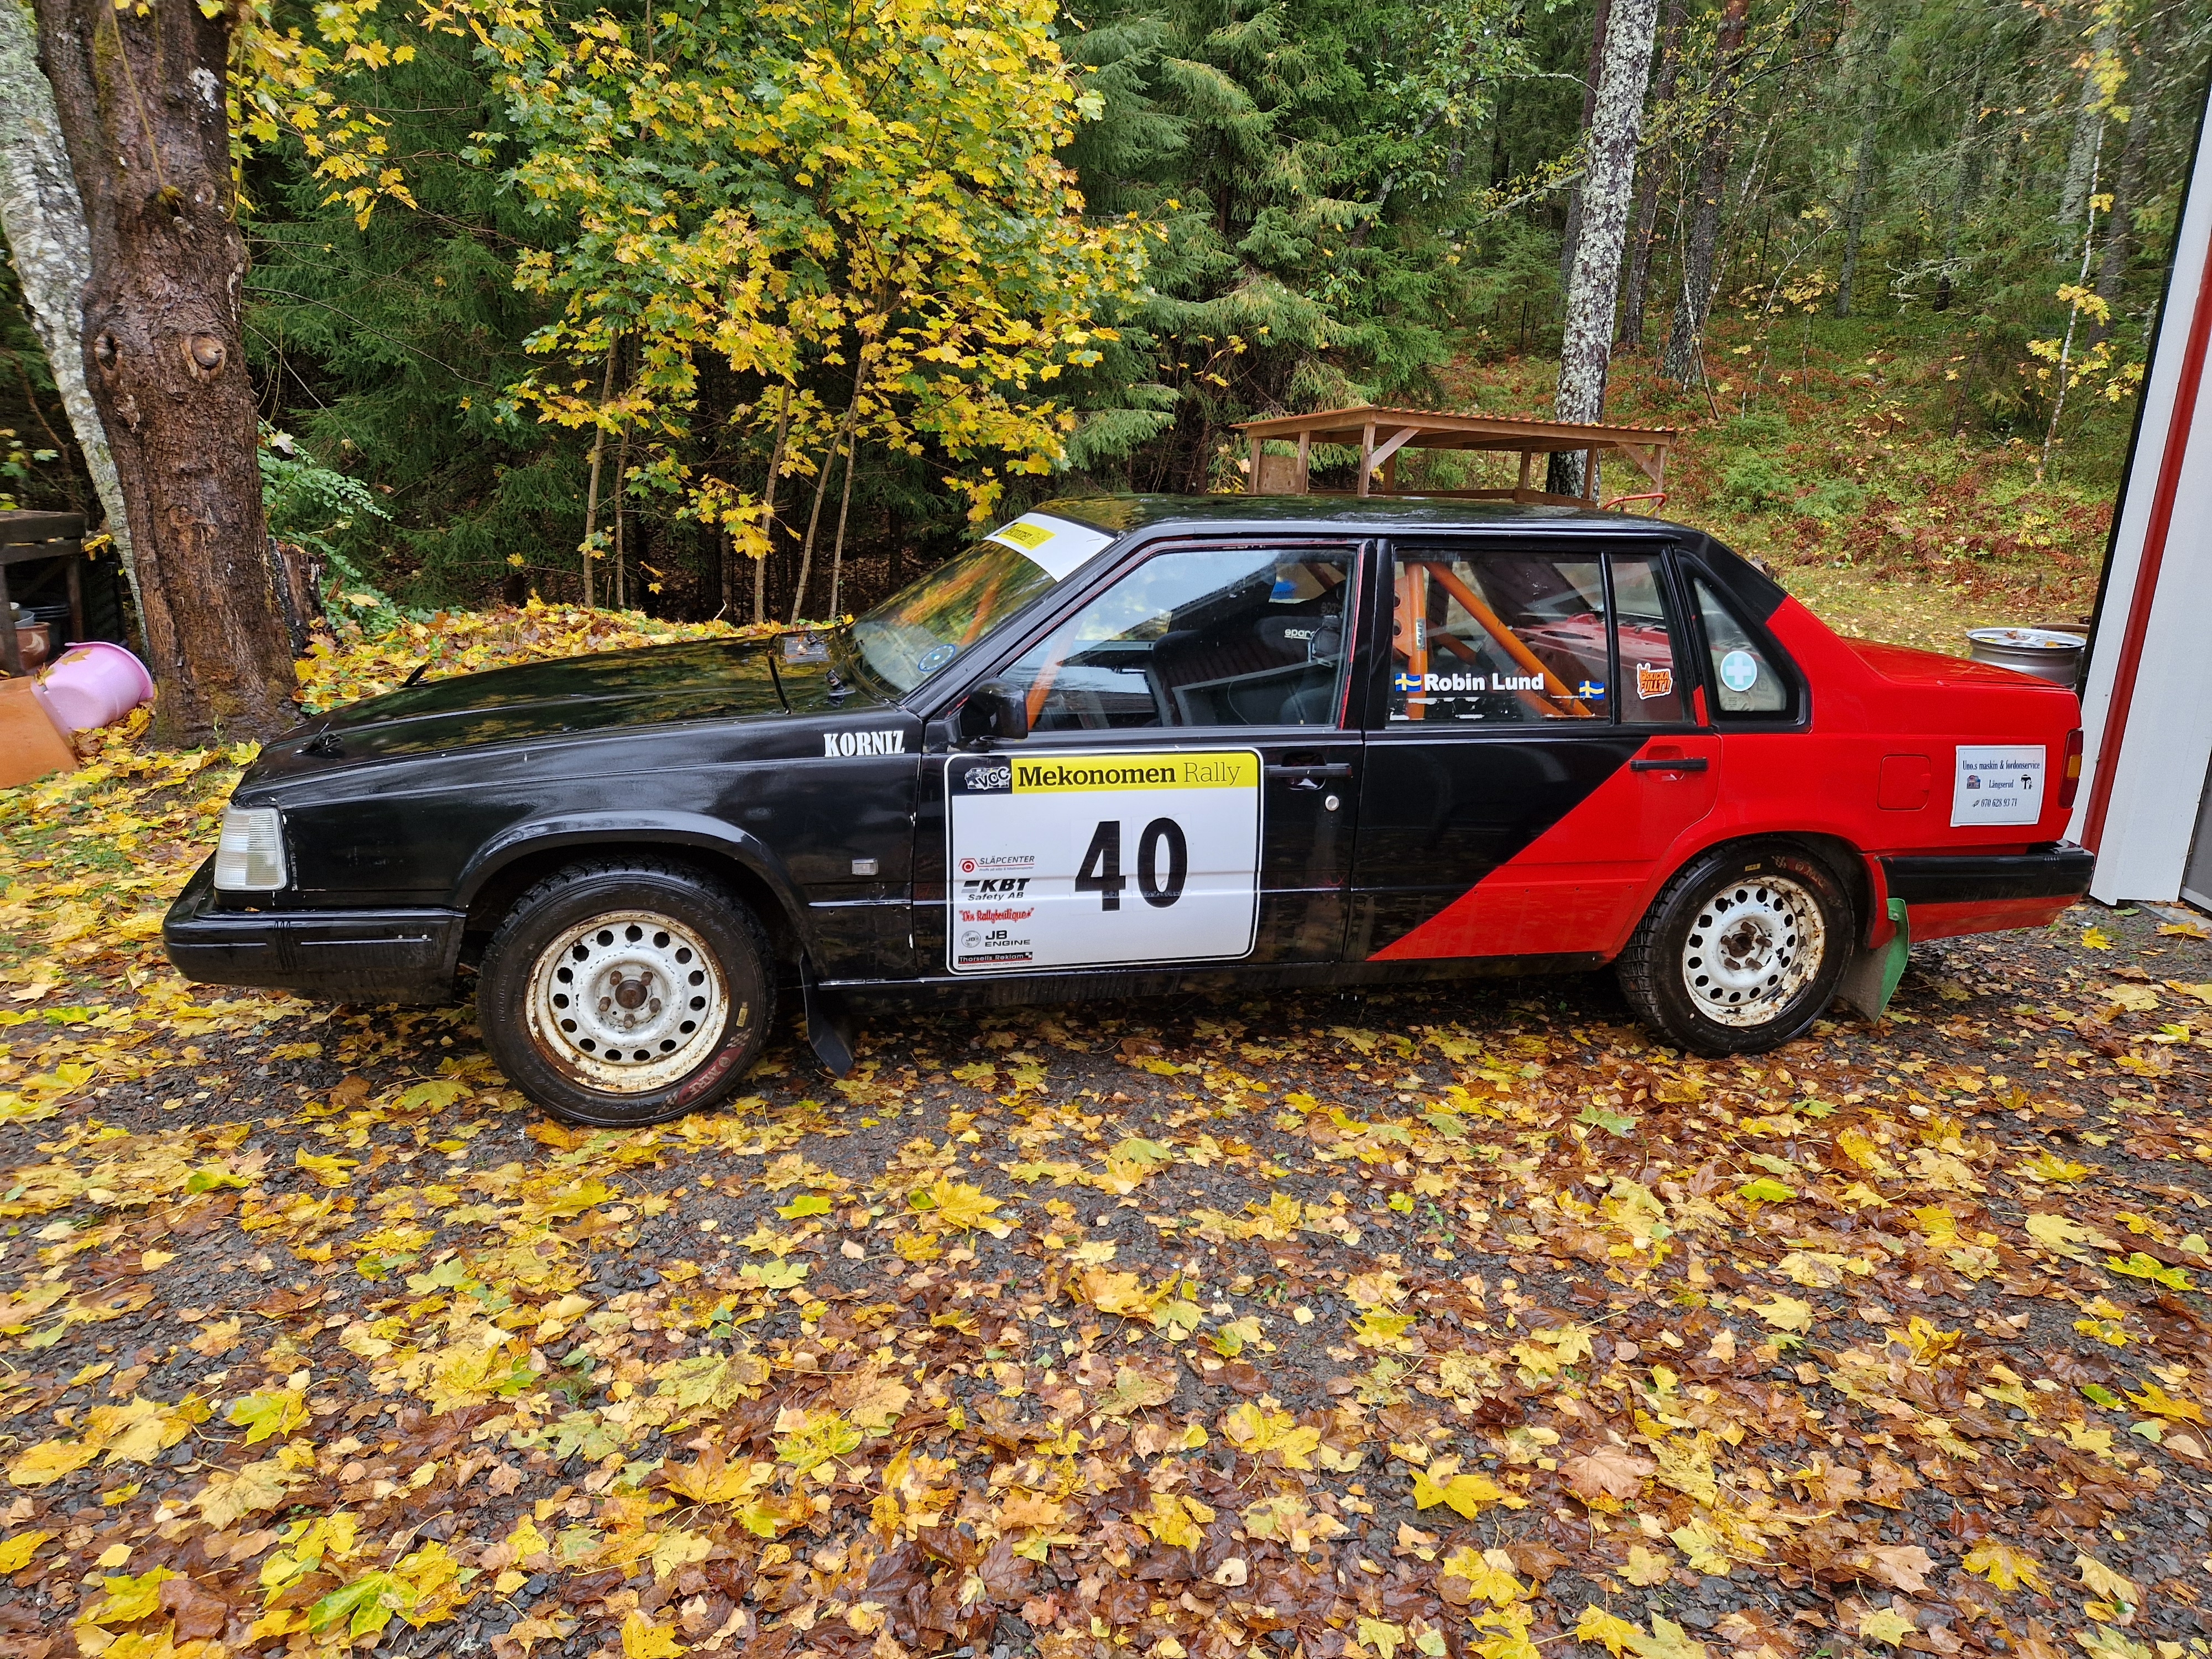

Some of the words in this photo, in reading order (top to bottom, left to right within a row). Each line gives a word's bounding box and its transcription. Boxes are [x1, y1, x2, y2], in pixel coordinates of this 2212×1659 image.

[1424, 673, 1485, 691] Robin
[1492, 672, 1545, 691] Lund
[1646, 671, 1669, 681] SKICKA
[1640, 679, 1671, 692] FULLT!!
[823, 730, 905, 758] KORNIZ
[1979, 760, 1998, 770] maskin
[2000, 760, 2004, 770] &
[2006, 760, 2040, 770] fordonservice
[976, 766, 1011, 791] VOC
[1018, 765, 1176, 787] Mekonomen
[1183, 761, 1241, 786] Rally
[1989, 779, 2014, 790] Långserud
[1981, 799, 1991, 807] 070
[1992, 799, 2002, 807] 628
[2004, 799, 2010, 807] 93
[2011, 798, 2017, 807] 71
[979, 855, 1035, 865] SLÄPCENTER
[1075, 817, 1187, 911] 40
[980, 878, 1031, 893] KBT
[985, 930, 1007, 940] JB
[689, 1066, 722, 1095] MRF
